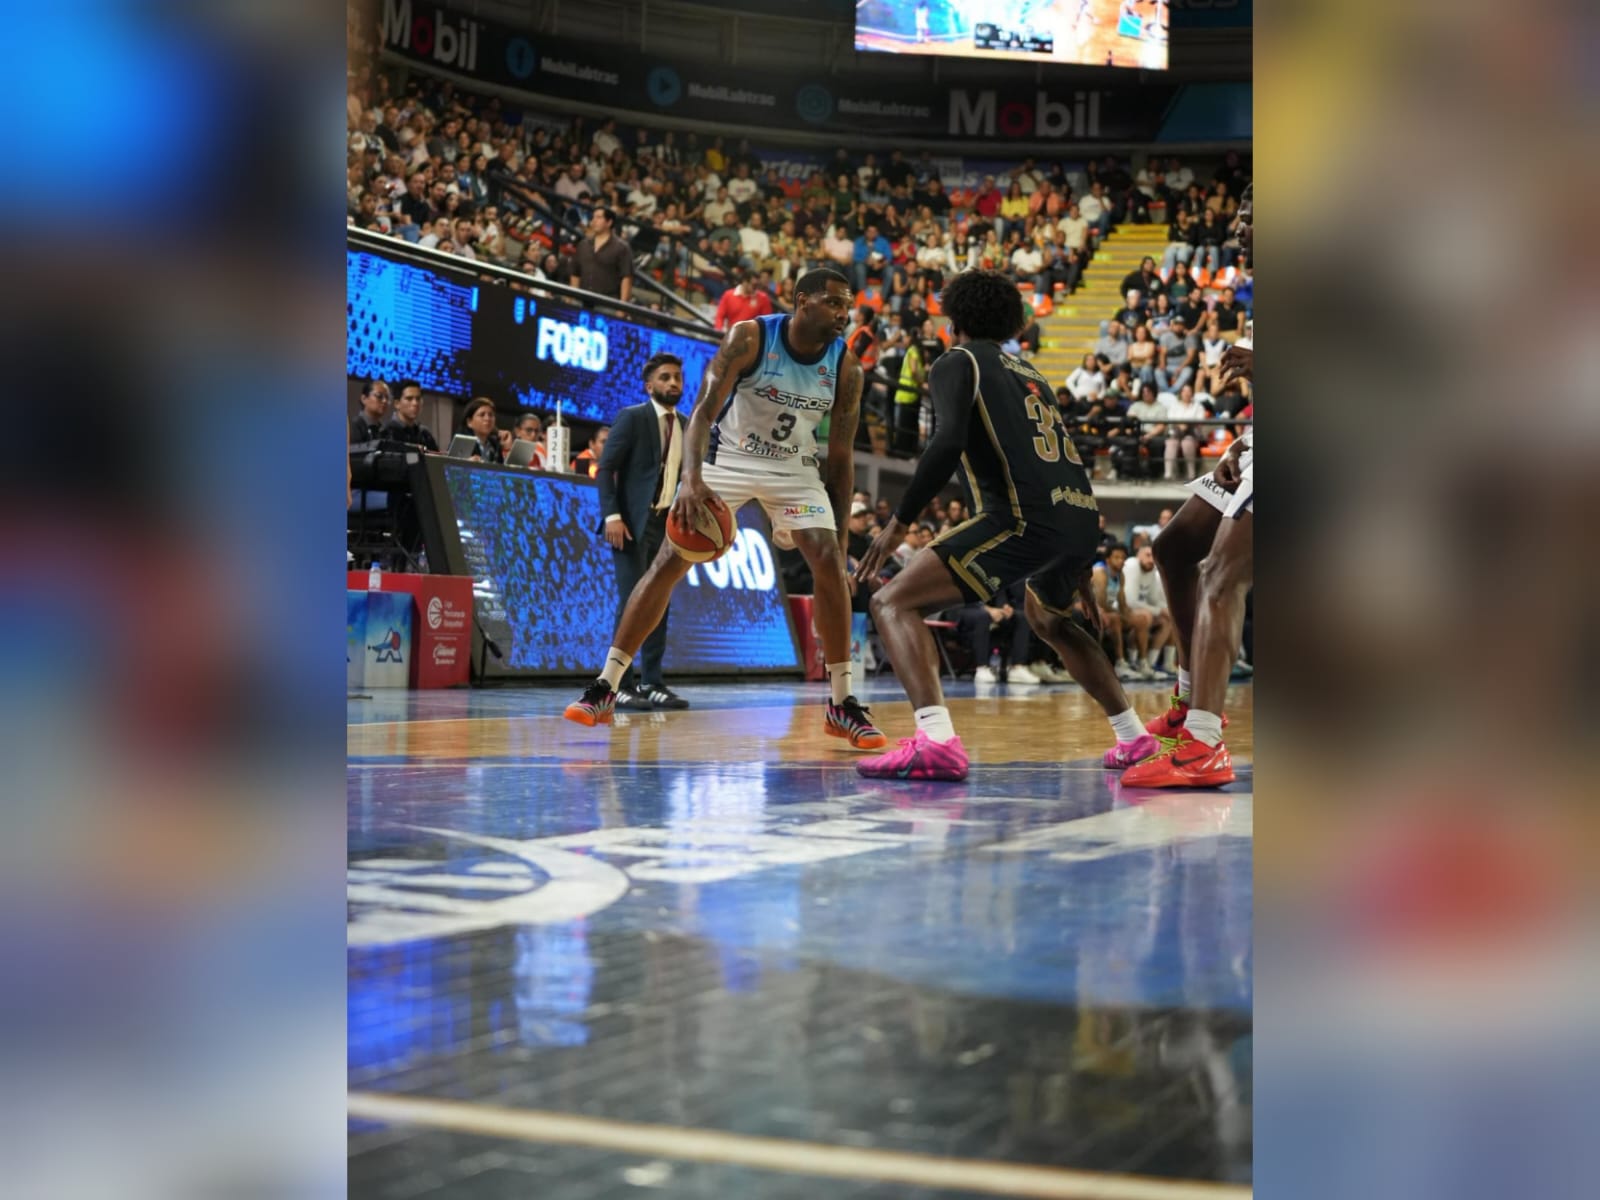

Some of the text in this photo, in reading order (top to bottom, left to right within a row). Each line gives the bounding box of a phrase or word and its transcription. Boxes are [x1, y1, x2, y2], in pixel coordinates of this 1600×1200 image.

[383, 0, 477, 71] Mobil
[948, 89, 1100, 137] Mobil
[537, 316, 608, 372] FORD
[753, 384, 833, 411] ASTROS
[771, 413, 797, 442] 3
[687, 528, 775, 591] ORD
